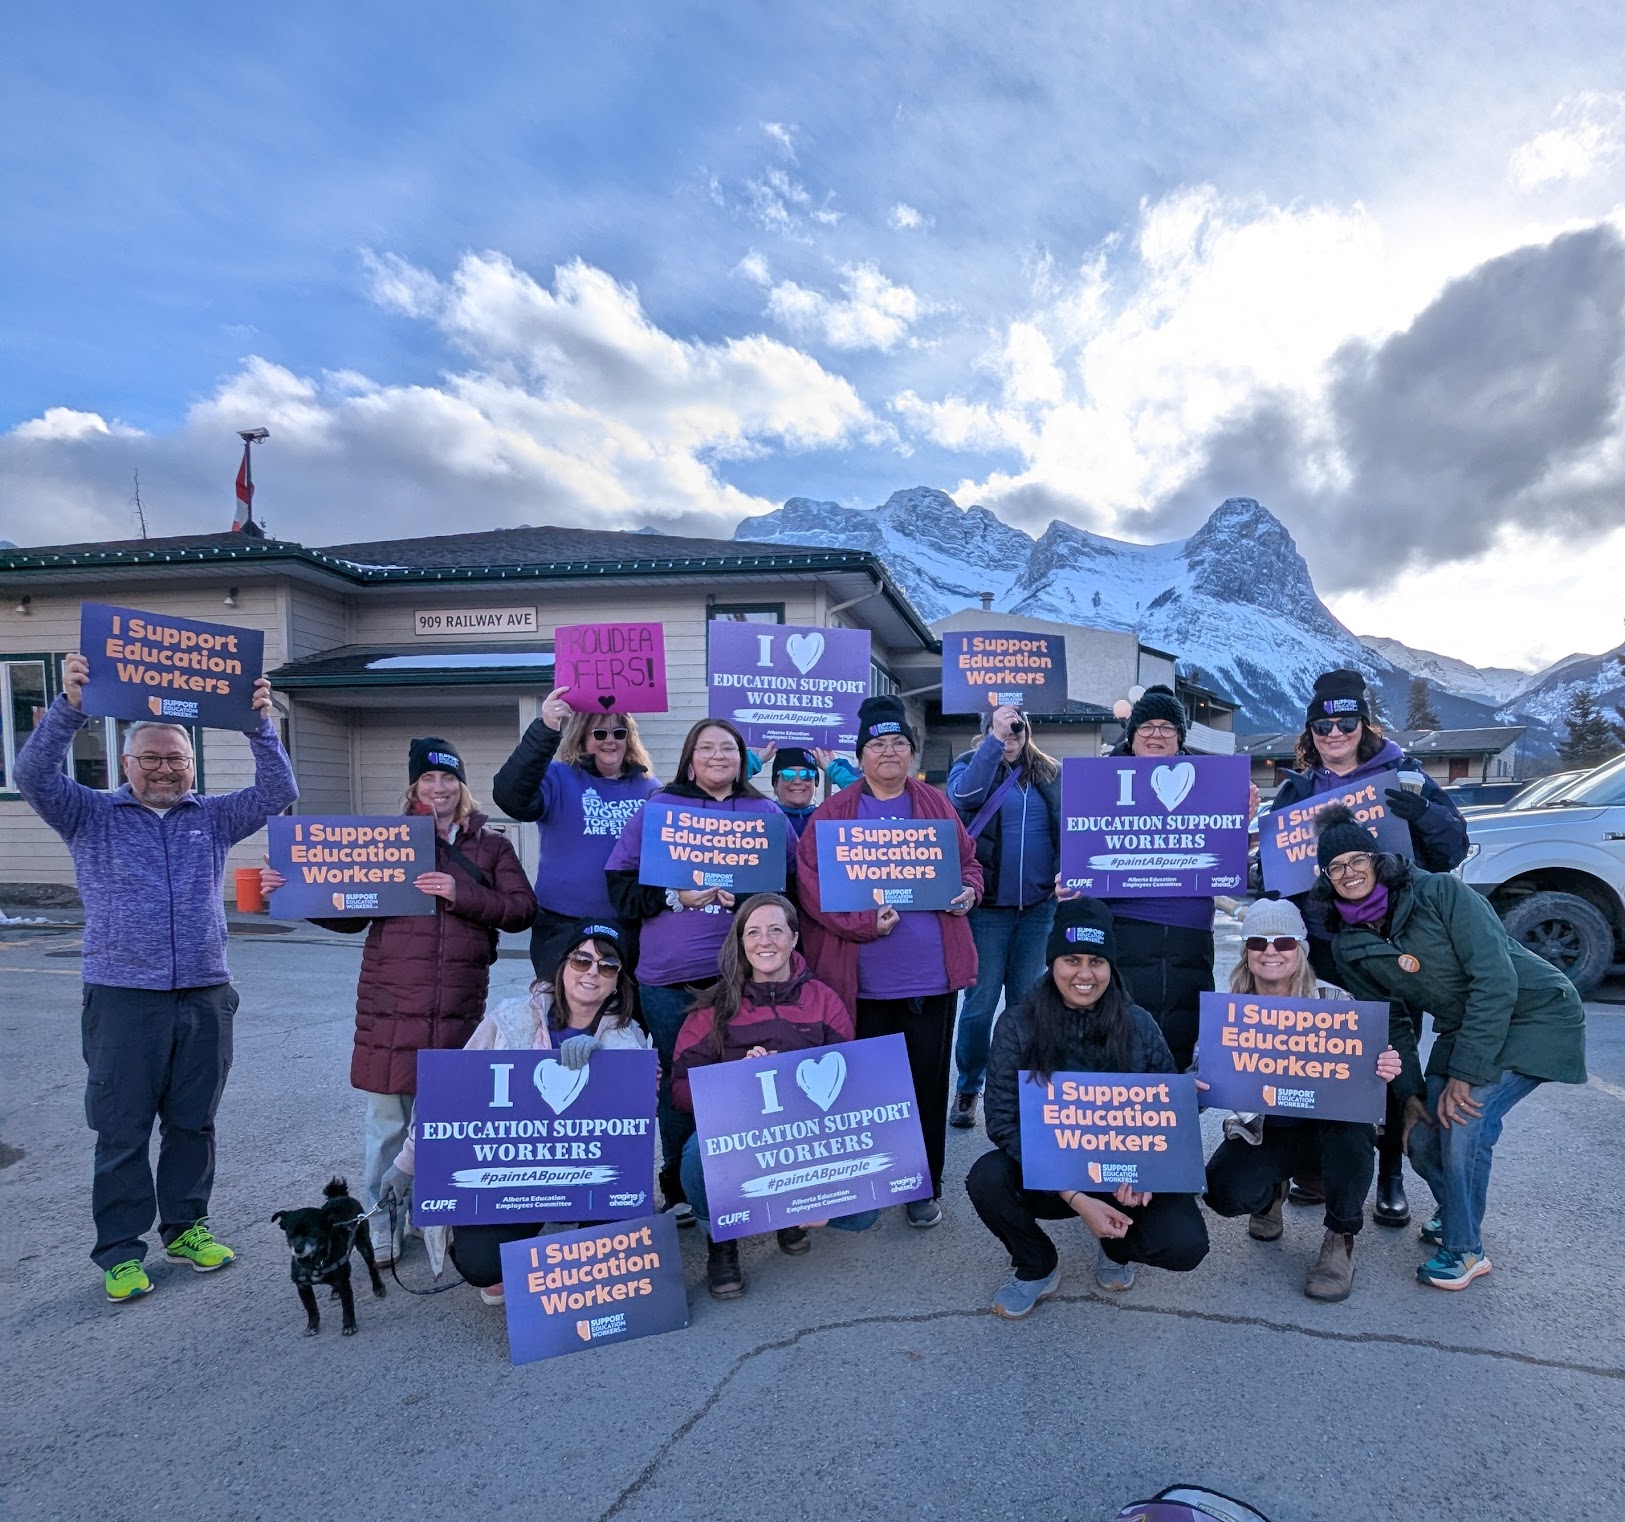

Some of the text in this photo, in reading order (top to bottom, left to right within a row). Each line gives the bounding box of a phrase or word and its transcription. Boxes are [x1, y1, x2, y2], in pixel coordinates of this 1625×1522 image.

[420, 614, 532, 628] 909 RAILWAY AVE
[113, 616, 238, 652] I Support
[562, 628, 625, 654] ROUD
[757, 635, 774, 666] I
[962, 637, 1047, 653] I Support
[106, 639, 241, 675] Education
[959, 652, 1052, 668] Education
[117, 663, 230, 694] Workers
[713, 673, 865, 693] EDUCATION SUPPORT
[966, 670, 1045, 685] Workers
[163, 700, 198, 708] SUPPORT
[747, 692, 833, 708] WORKERS
[752, 712, 827, 723] #paintABpurple
[1117, 770, 1136, 805] I
[582, 797, 646, 809] EDUCATIO
[583, 806, 636, 818] WORK
[583, 827, 607, 835] ARE
[666, 811, 764, 833] I Support
[1067, 815, 1244, 831] EDUCATION SUPPORT
[1276, 804, 1384, 848] Eduon
[1278, 815, 1284, 829] I
[295, 824, 410, 844] I Support
[661, 827, 768, 849] Education
[839, 827, 936, 844] I Support
[1105, 834, 1205, 849] WORKERS
[291, 843, 415, 862] Education
[669, 845, 759, 865] Workers
[836, 843, 942, 861] Education
[1111, 857, 1198, 867] #paintABpurple
[302, 866, 405, 883] Workers
[846, 864, 936, 880] Workers
[1067, 879, 1093, 887] CUPE
[1228, 1003, 1358, 1031] I Support
[1222, 1026, 1362, 1056] Education
[1232, 1051, 1350, 1080] Workers
[489, 1064, 514, 1107] I
[755, 1070, 783, 1114] I
[1048, 1082, 1169, 1106] I Support
[1278, 1088, 1315, 1097] SUPPORT
[1043, 1105, 1176, 1127] Education
[423, 1118, 649, 1140] EDUCATION SUPPORT
[706, 1102, 911, 1156] EDUCATION SUPPORT
[1055, 1129, 1167, 1151] Workers
[473, 1141, 601, 1162] WORKERS
[755, 1132, 874, 1169] WORKERS
[480, 1170, 592, 1183] #paintABpurple
[768, 1160, 869, 1189] #paintABpurple
[421, 1200, 457, 1209] CUPE
[787, 1194, 857, 1213] Employees Committee
[792, 1189, 849, 1205] Alberta Education
[717, 1210, 750, 1226] CUPE
[531, 1226, 652, 1267] I Support
[528, 1252, 660, 1293] Education
[541, 1278, 652, 1315] Workers
[591, 1313, 624, 1327] SUPPORT
[591, 1321, 626, 1333] EDUCATION
